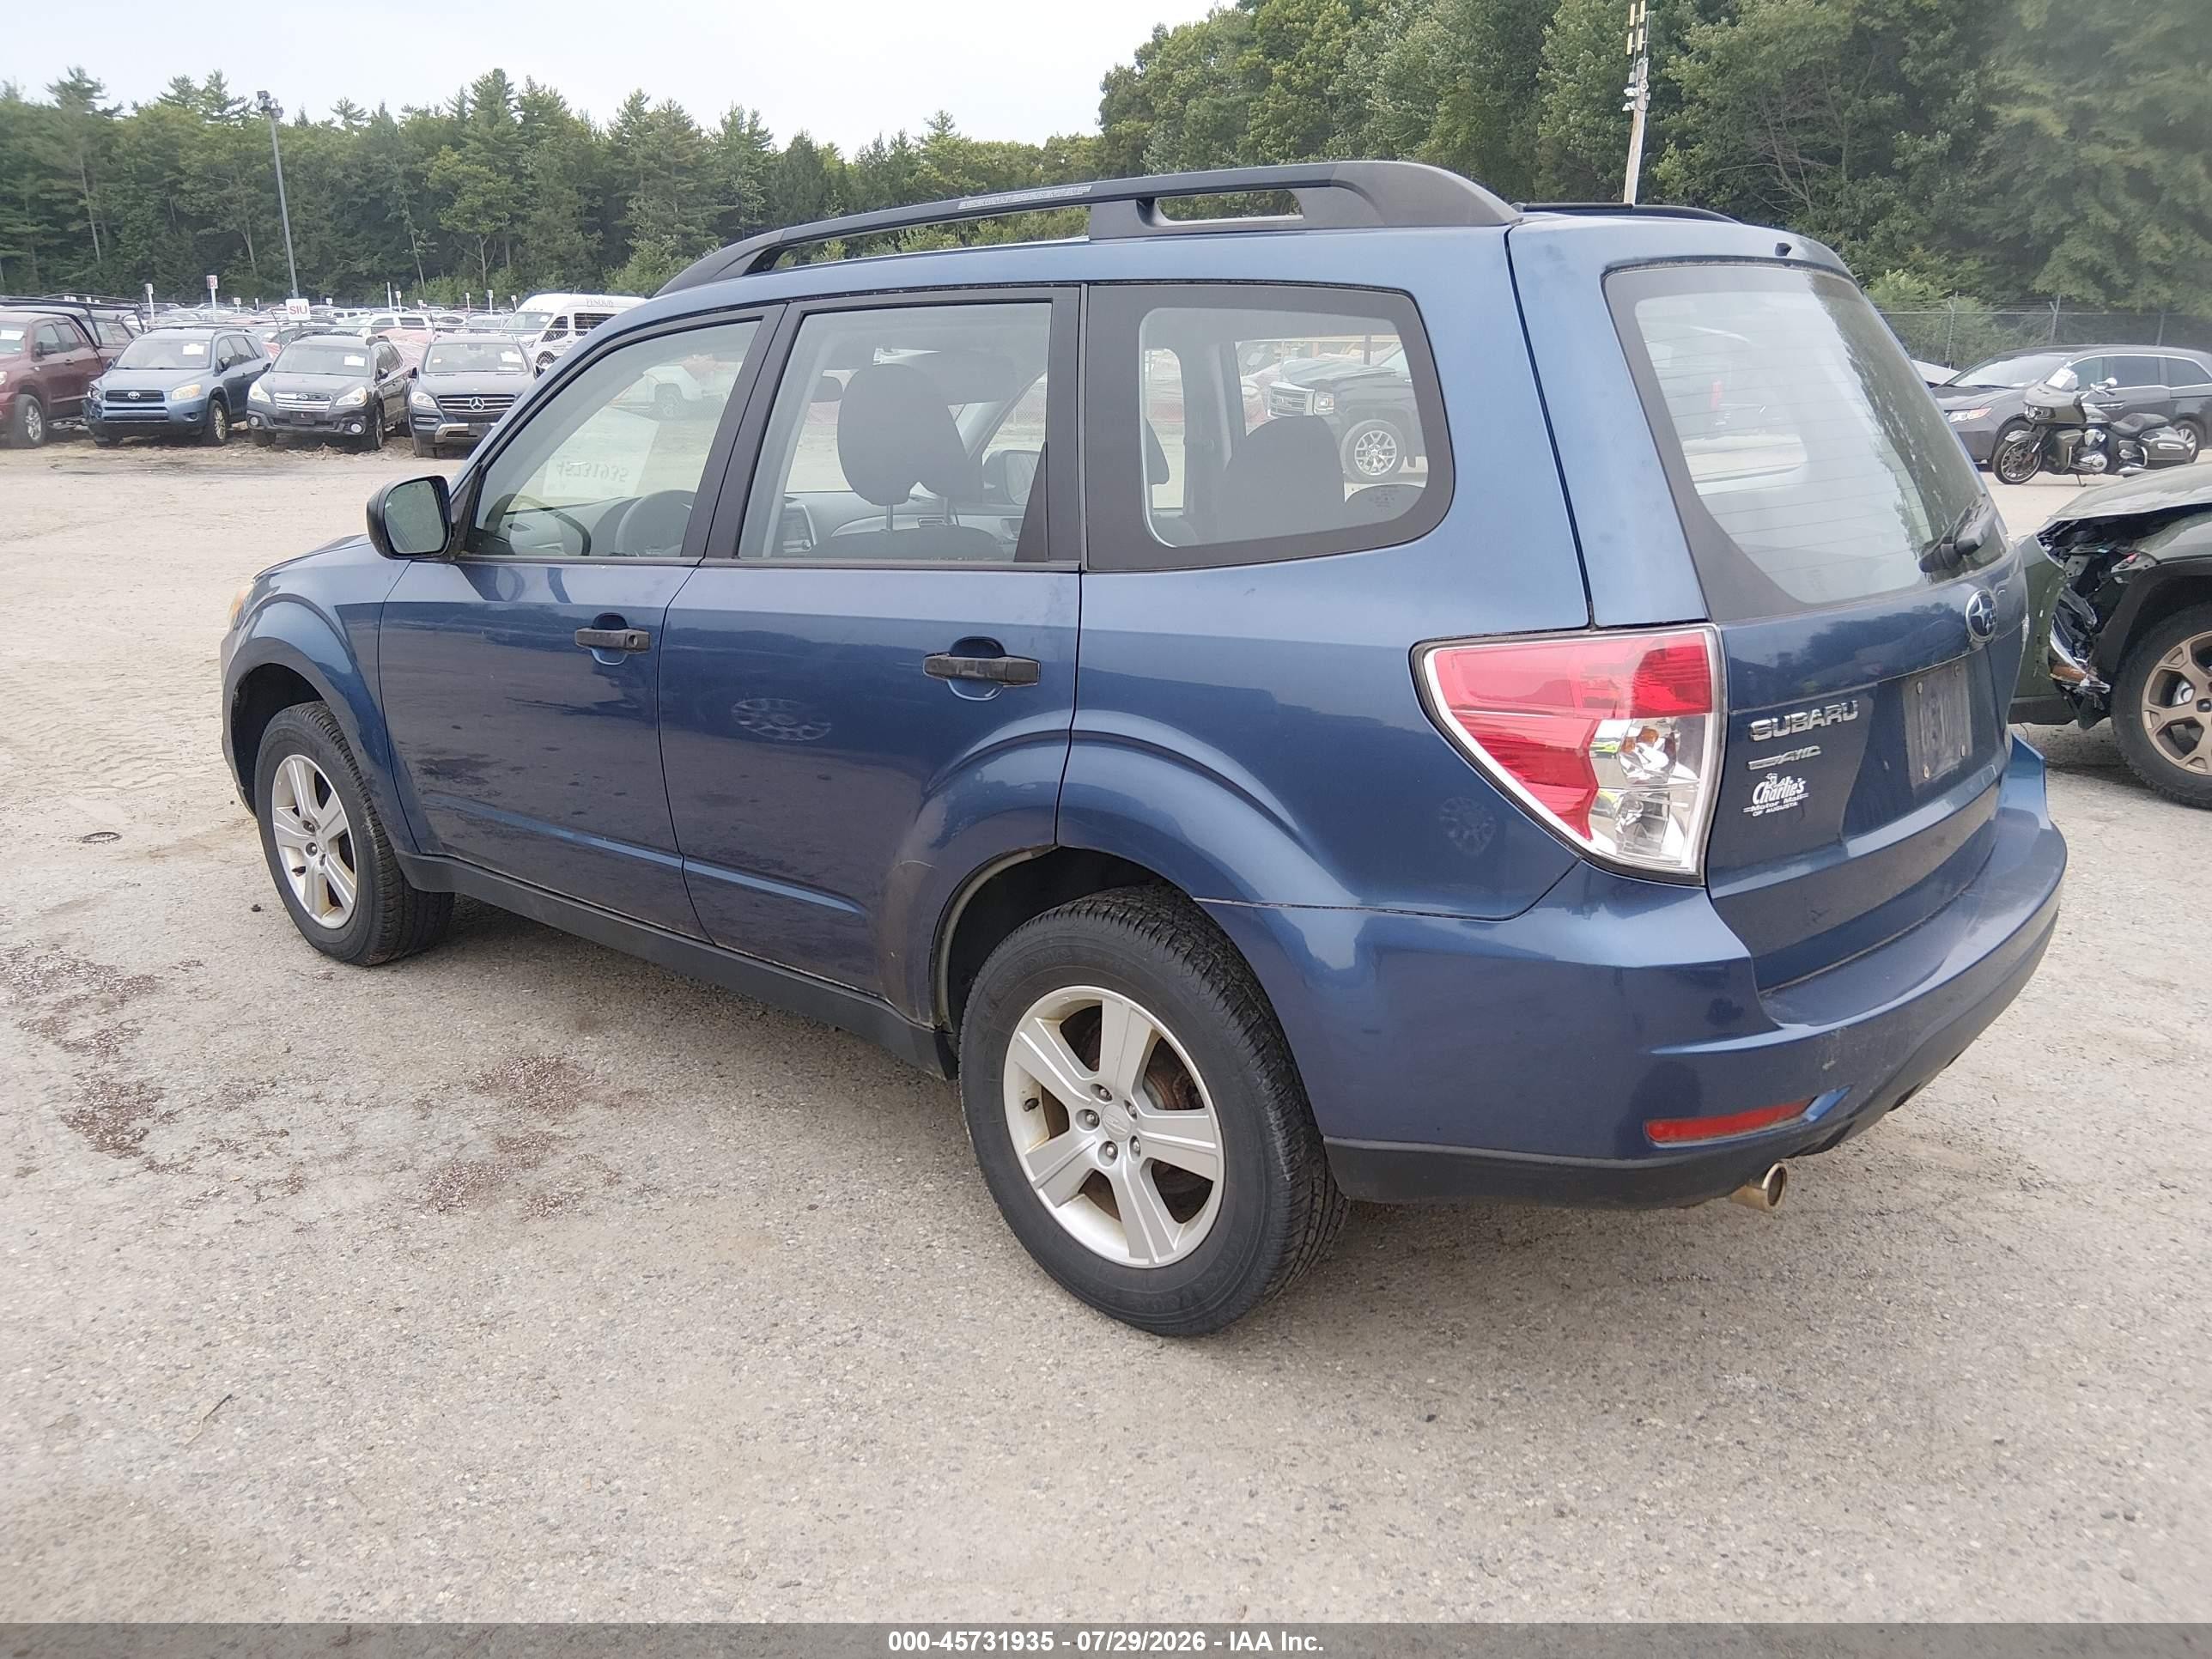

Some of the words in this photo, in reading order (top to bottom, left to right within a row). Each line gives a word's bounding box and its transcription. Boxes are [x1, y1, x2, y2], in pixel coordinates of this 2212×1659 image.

[289, 306, 307, 315] SIU
[1749, 700, 1859, 742] SUBARU
[1752, 776, 1808, 805] Charlie's
[1751, 799, 1780, 812] Motor
